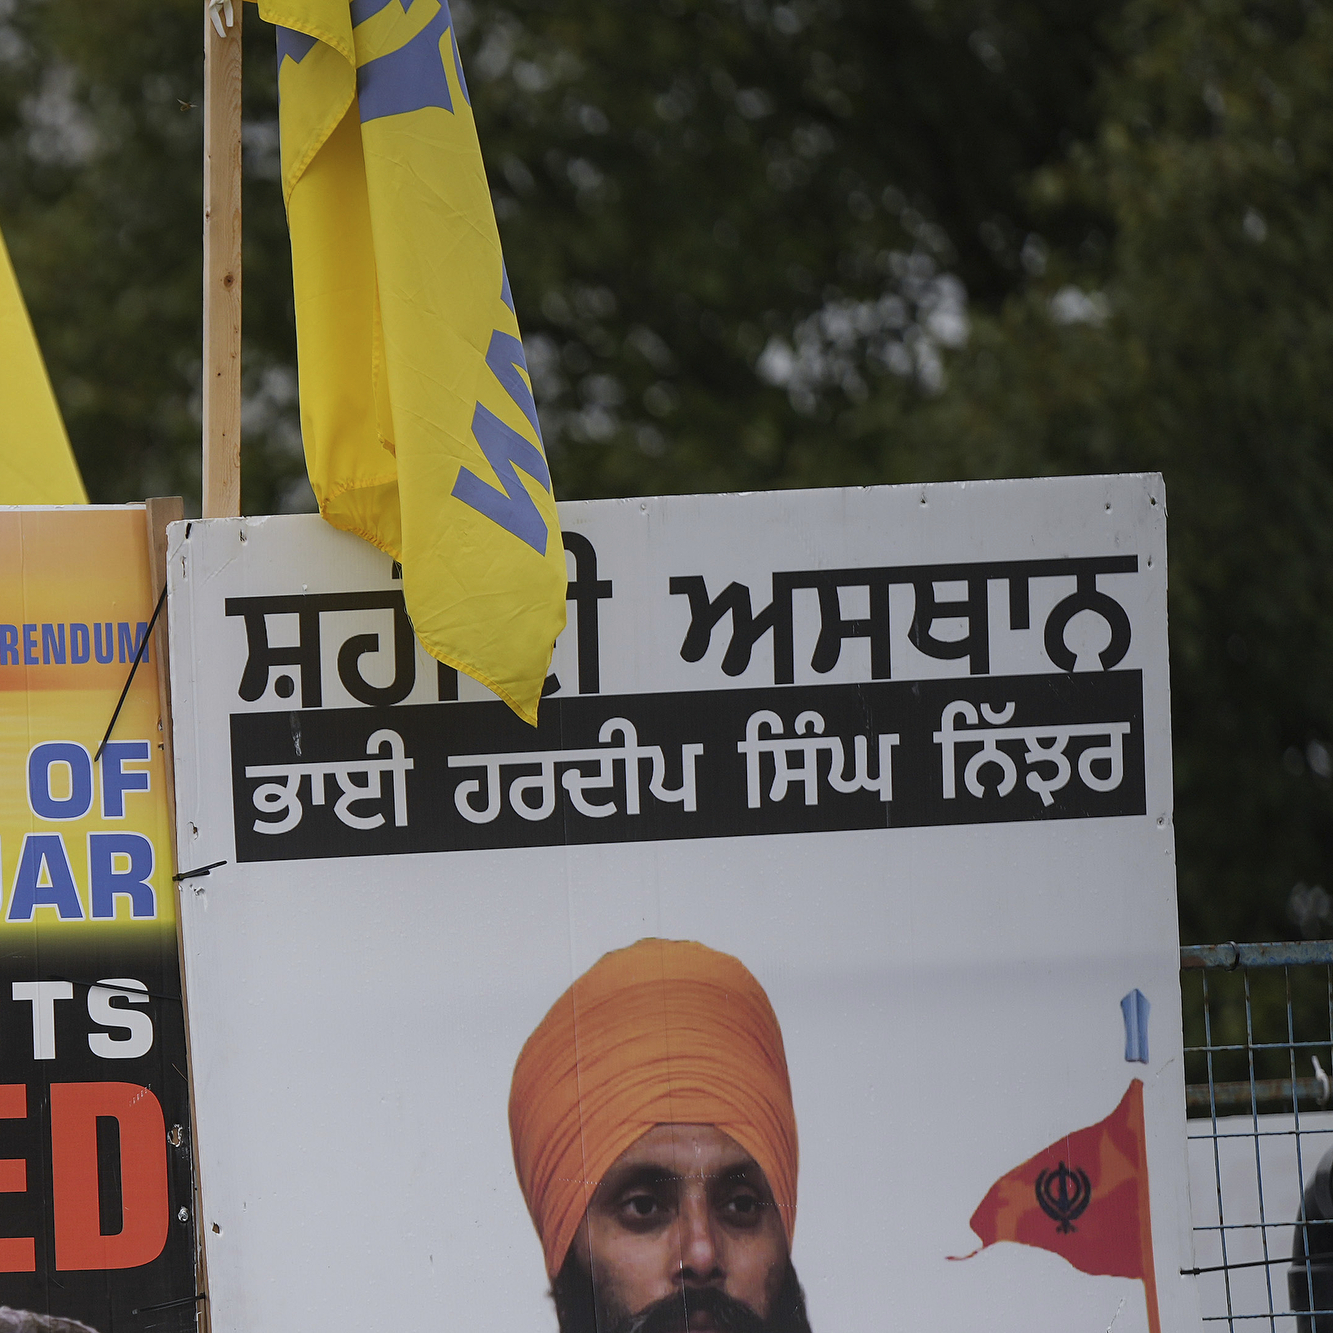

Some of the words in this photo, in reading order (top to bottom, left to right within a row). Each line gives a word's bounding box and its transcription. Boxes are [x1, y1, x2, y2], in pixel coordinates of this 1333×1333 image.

[669, 554, 1138, 684] ਅਸਥਾਨ
[27, 740, 152, 822] OF
[245, 729, 414, 834] ਭਾਈ
[448, 717, 704, 824] ਹਰਦੀਪ
[737, 710, 900, 808] ਸਿੰਘ
[933, 700, 1131, 806] ਨਿੱਝਰ
